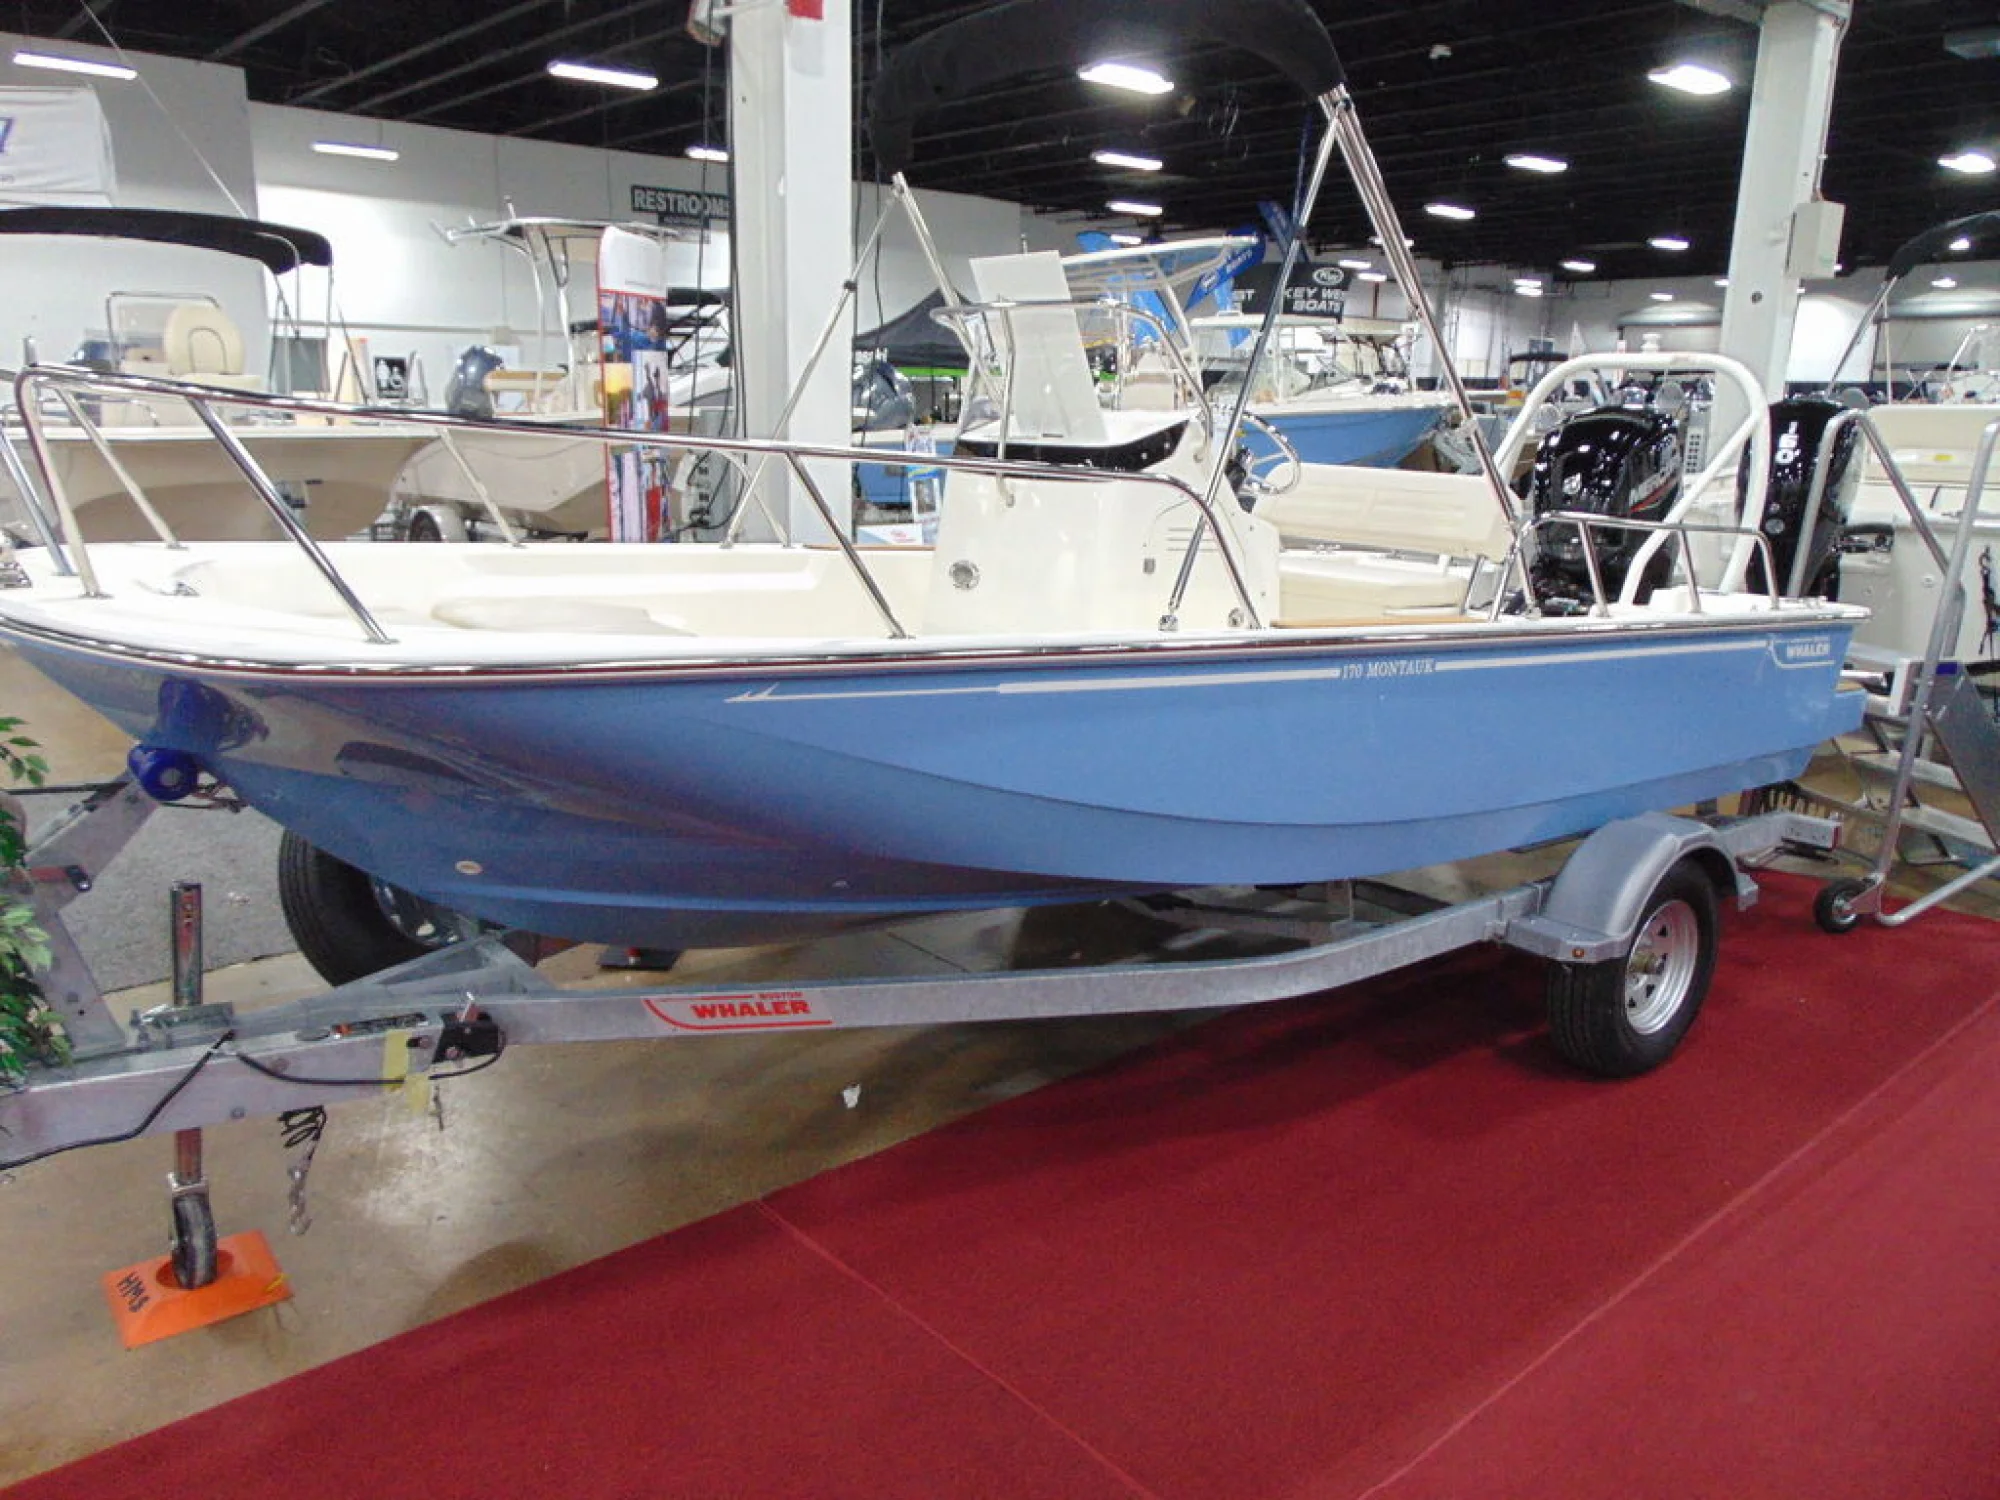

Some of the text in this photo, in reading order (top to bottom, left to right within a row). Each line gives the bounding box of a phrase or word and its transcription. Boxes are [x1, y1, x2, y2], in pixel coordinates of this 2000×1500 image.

[1786, 642, 1829, 659] WHALER
[1343, 658, 1436, 679] 170 MONTAUK
[691, 999, 812, 1019] WHALER
